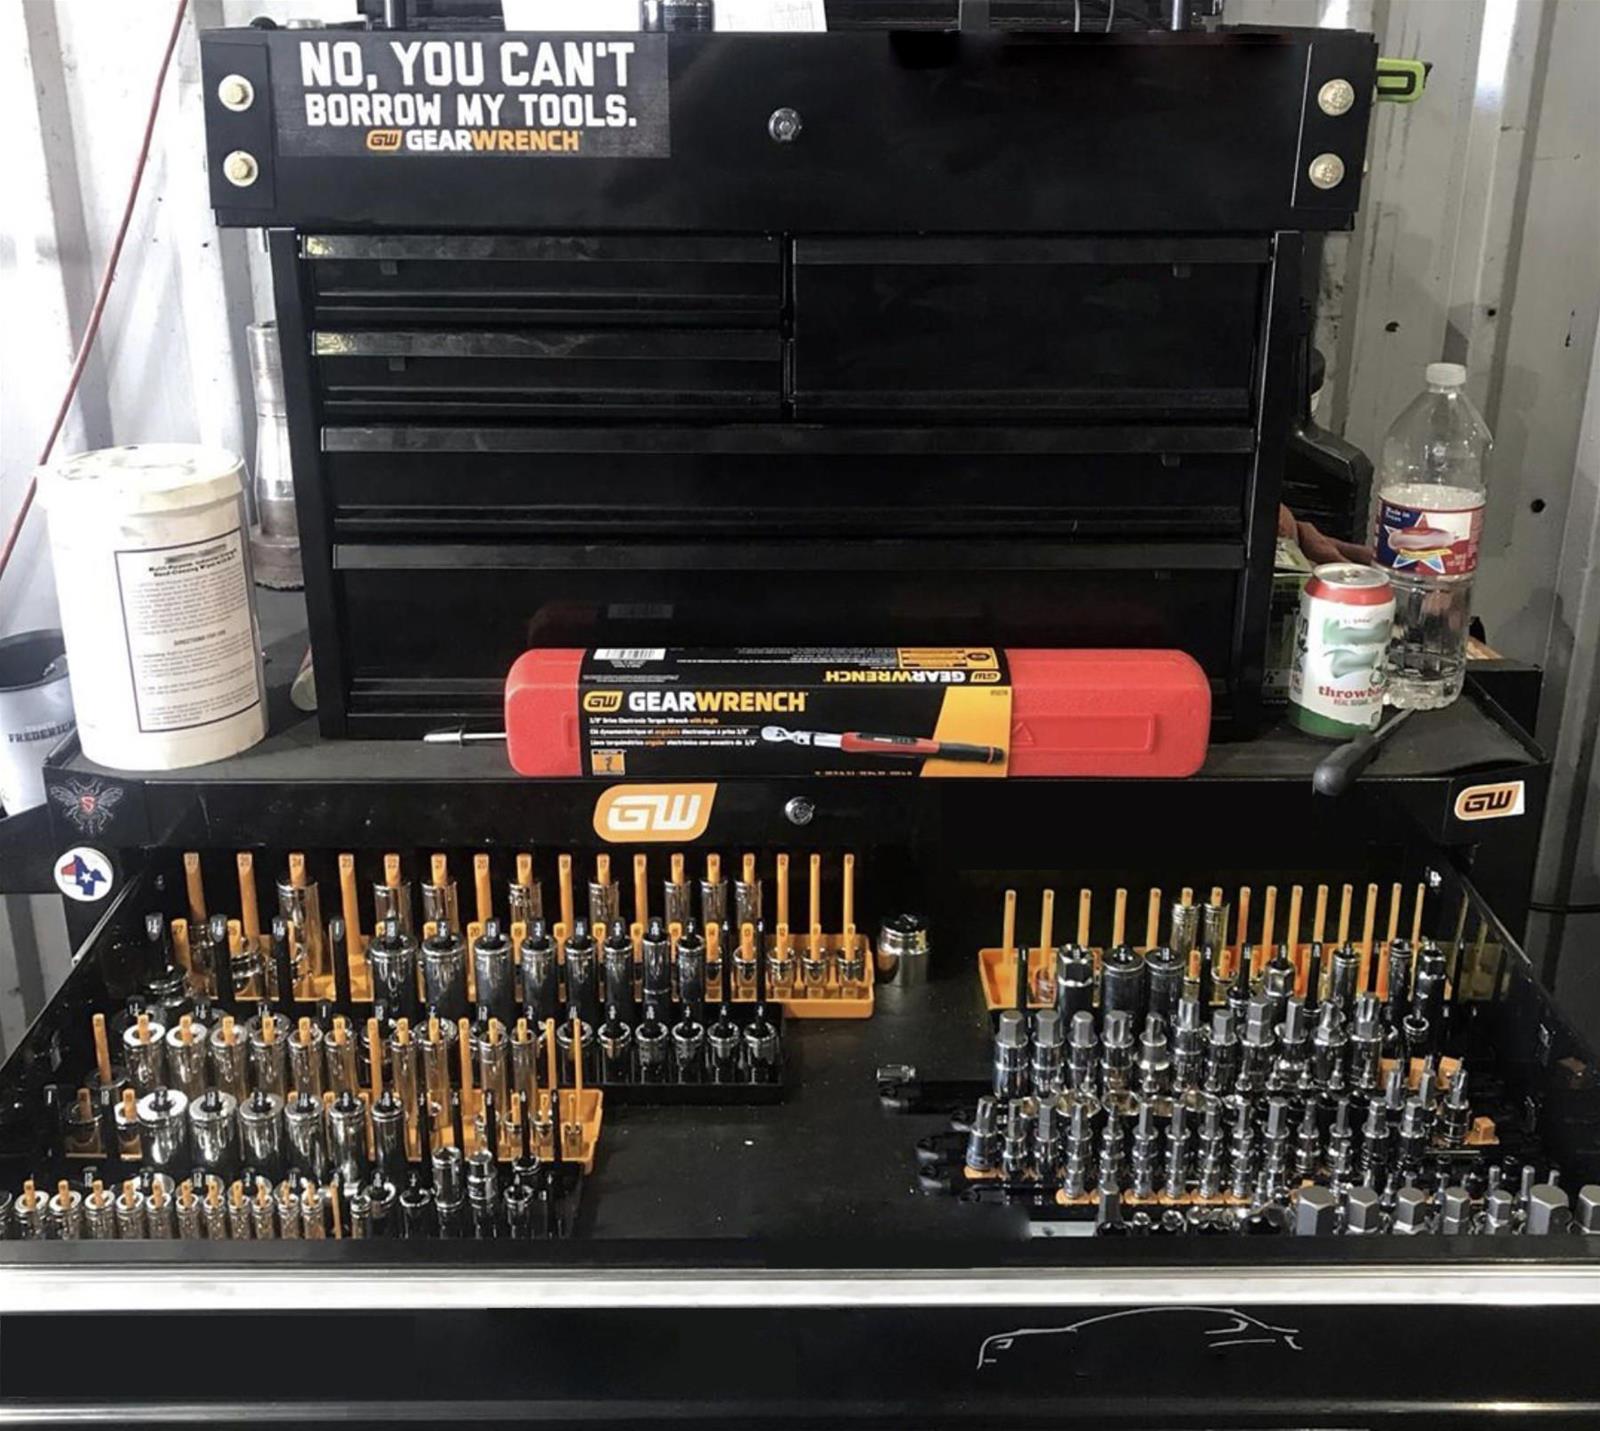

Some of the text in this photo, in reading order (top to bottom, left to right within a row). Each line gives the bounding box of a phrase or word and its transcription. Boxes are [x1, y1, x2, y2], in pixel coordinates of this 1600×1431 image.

[300, 42, 636, 91] NO, YOU CAN'T
[305, 94, 637, 127] BORROW MY TOOLS.
[406, 129, 580, 151] GEARWRENCH
[825, 670, 966, 683] GEARWRENCH
[628, 691, 806, 712] GEARWRENCH
[1464, 790, 1512, 812] GW
[607, 794, 702, 831] GW
